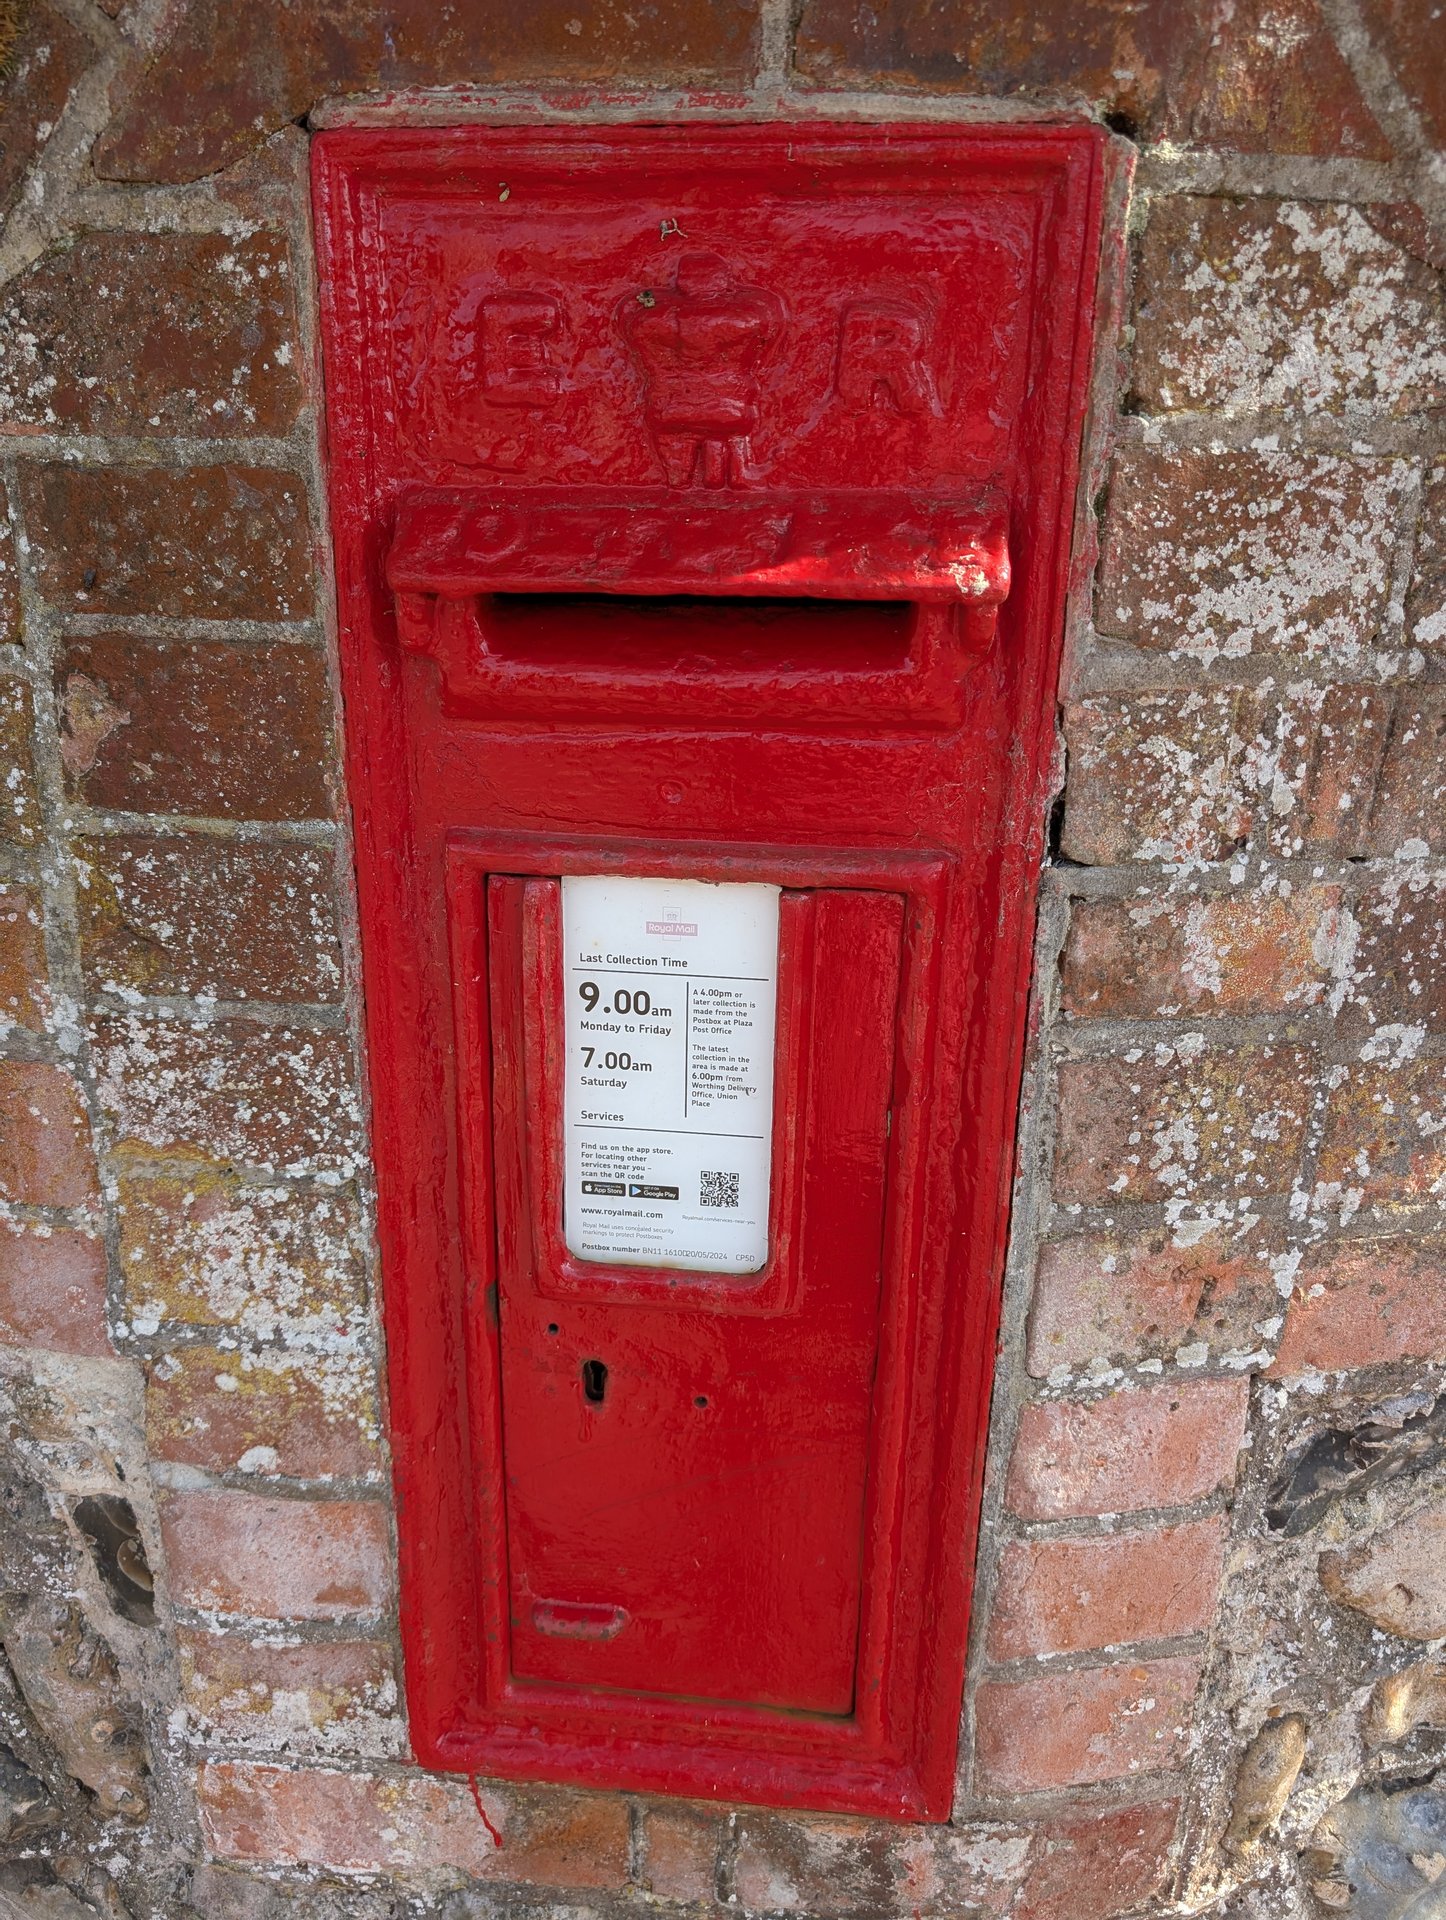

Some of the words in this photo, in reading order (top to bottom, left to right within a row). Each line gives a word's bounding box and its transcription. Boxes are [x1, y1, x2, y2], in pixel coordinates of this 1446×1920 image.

[648, 923, 674, 934] Royal
[675, 924, 696, 934] Mail
[580, 952, 603, 963] Last
[606, 954, 658, 967] Collection
[661, 957, 688, 968] Time
[700, 988, 732, 998] 4.00pm
[579, 981, 672, 1017] 9.00am
[712, 1000, 747, 1008] collection
[693, 1017, 722, 1025] Postbox
[733, 1019, 753, 1027] Plaza
[580, 1021, 621, 1033] Monday
[624, 1024, 635, 1033] to
[639, 1024, 672, 1036] Friday
[711, 1027, 732, 1035] Office
[708, 1045, 729, 1053] latest
[580, 1046, 652, 1072] 7.00am
[692, 1072, 723, 1082] 6.00pm
[580, 1076, 628, 1090] Saturday
[692, 1082, 725, 1091] Worthing
[727, 1084, 757, 1093] Delivery
[692, 1091, 715, 1099] Office,
[717, 1092, 738, 1100] Union
[692, 1100, 711, 1108] Place
[581, 1110, 625, 1123] Services
[581, 1142, 597, 1150] Find
[581, 1151, 593, 1159] For
[595, 1152, 625, 1162] locating
[581, 1161, 611, 1169] services
[614, 1171, 625, 1179] QR
[594, 1186, 607, 1194] App
[643, 1189, 664, 1198] Google
[664, 1191, 677, 1199] Play
[580, 1207, 663, 1219] www.royalmail.com
[582, 1221, 597, 1229] Royal
[652, 1226, 675, 1235] security
[582, 1229, 607, 1237] markings
[615, 1231, 635, 1239] protect
[636, 1232, 663, 1240] Postboxes
[582, 1242, 610, 1251] Postbox
[612, 1244, 641, 1253] number
[642, 1246, 661, 1255] BN11
